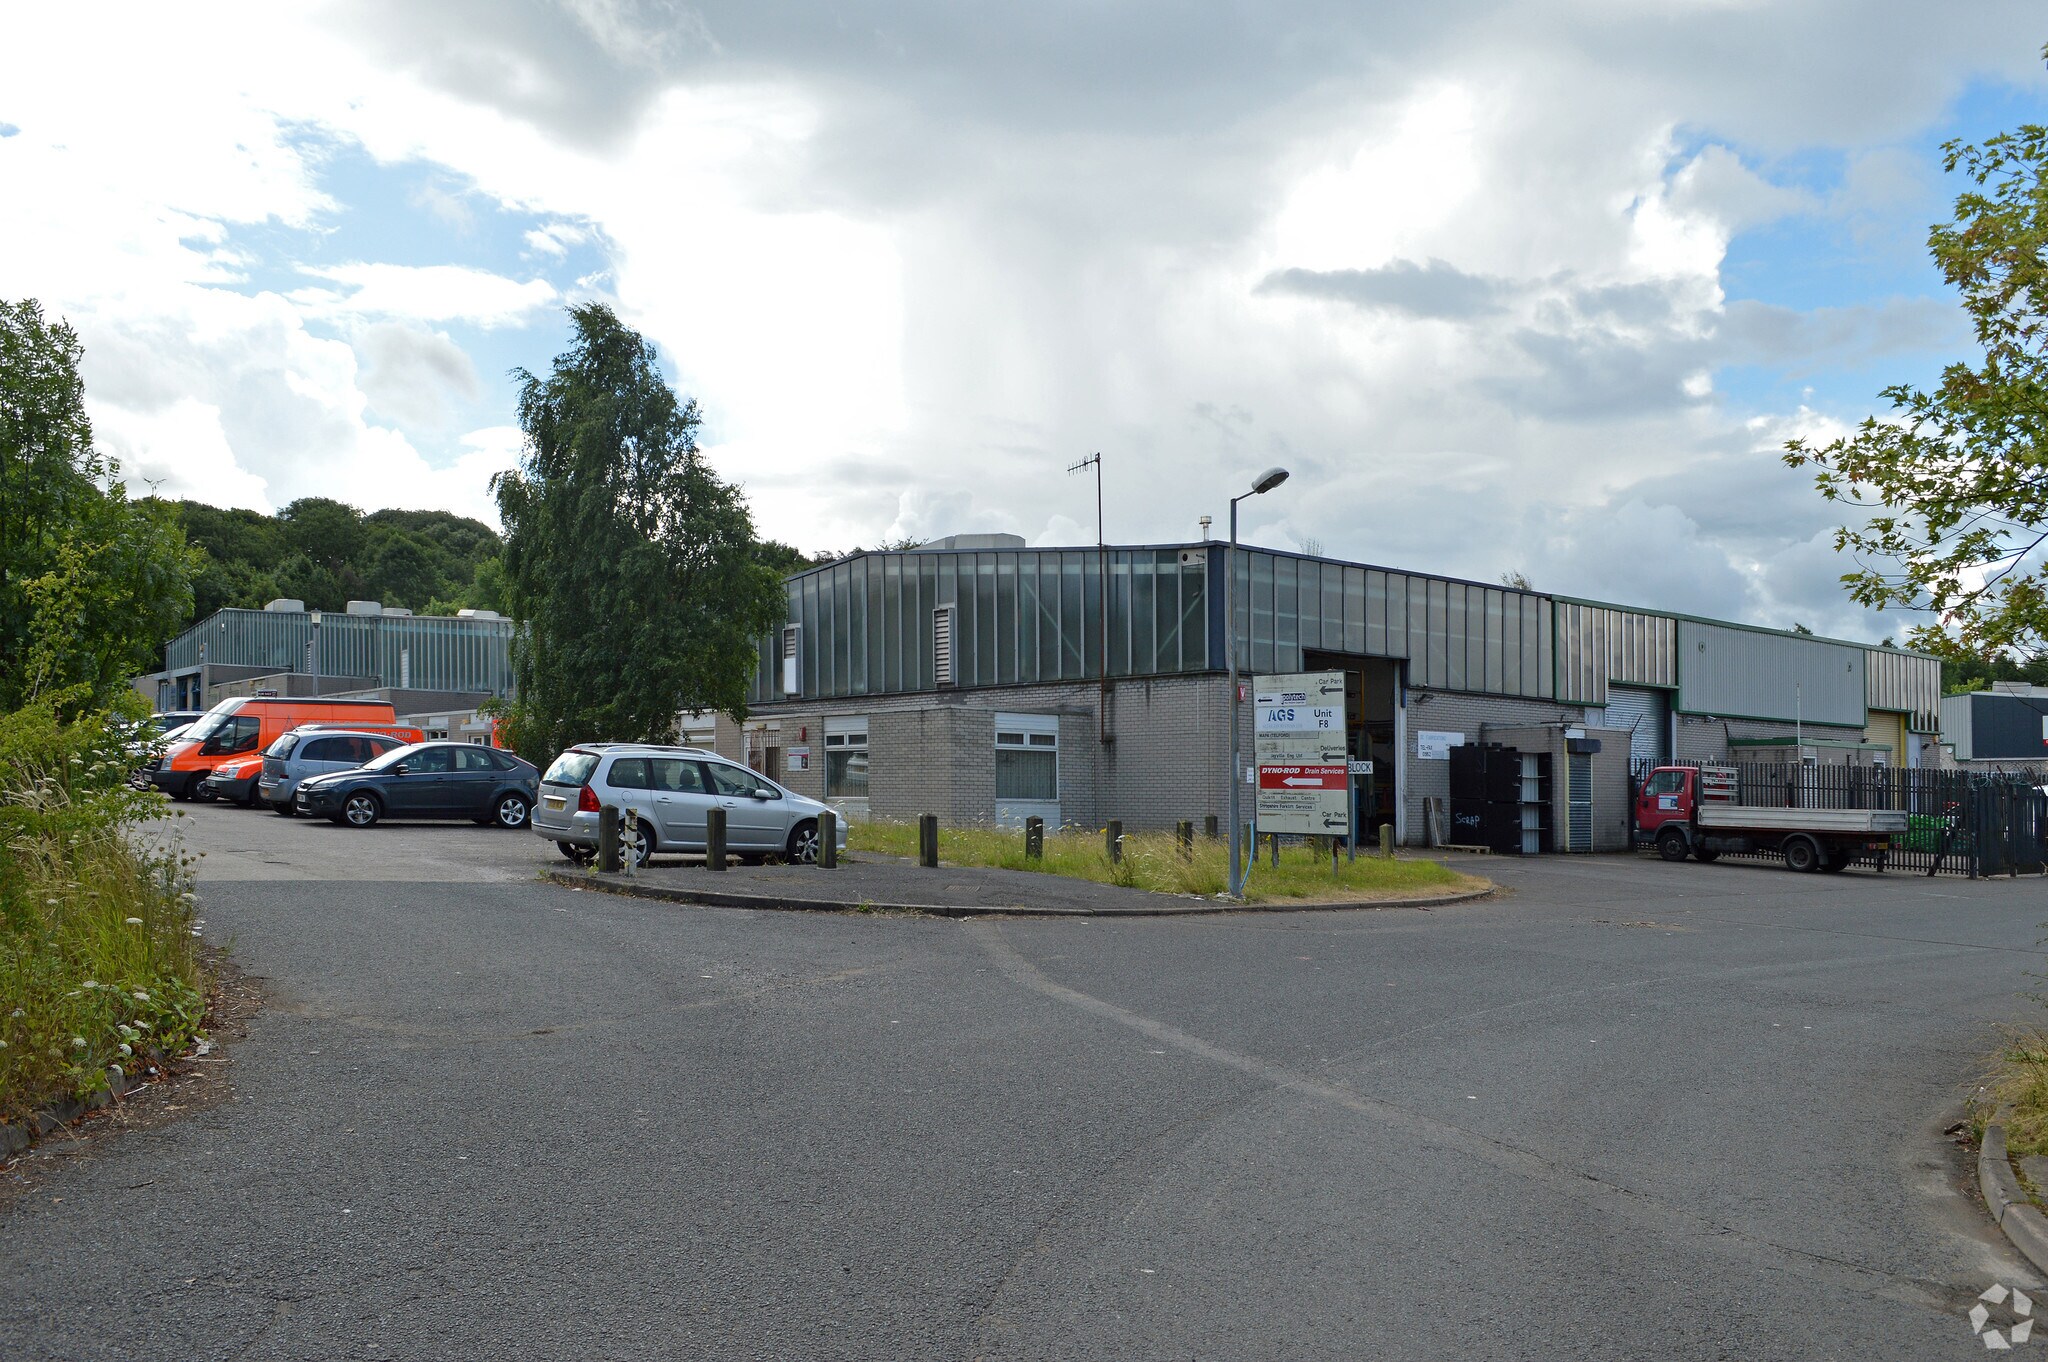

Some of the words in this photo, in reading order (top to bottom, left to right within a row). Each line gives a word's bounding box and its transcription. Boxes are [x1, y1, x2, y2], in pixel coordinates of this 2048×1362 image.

[1268, 708, 1295, 721] AGS
[1313, 708, 1332, 718] Unit
[1318, 719, 1329, 728] F8
[1348, 762, 1371, 773] BLOCK
